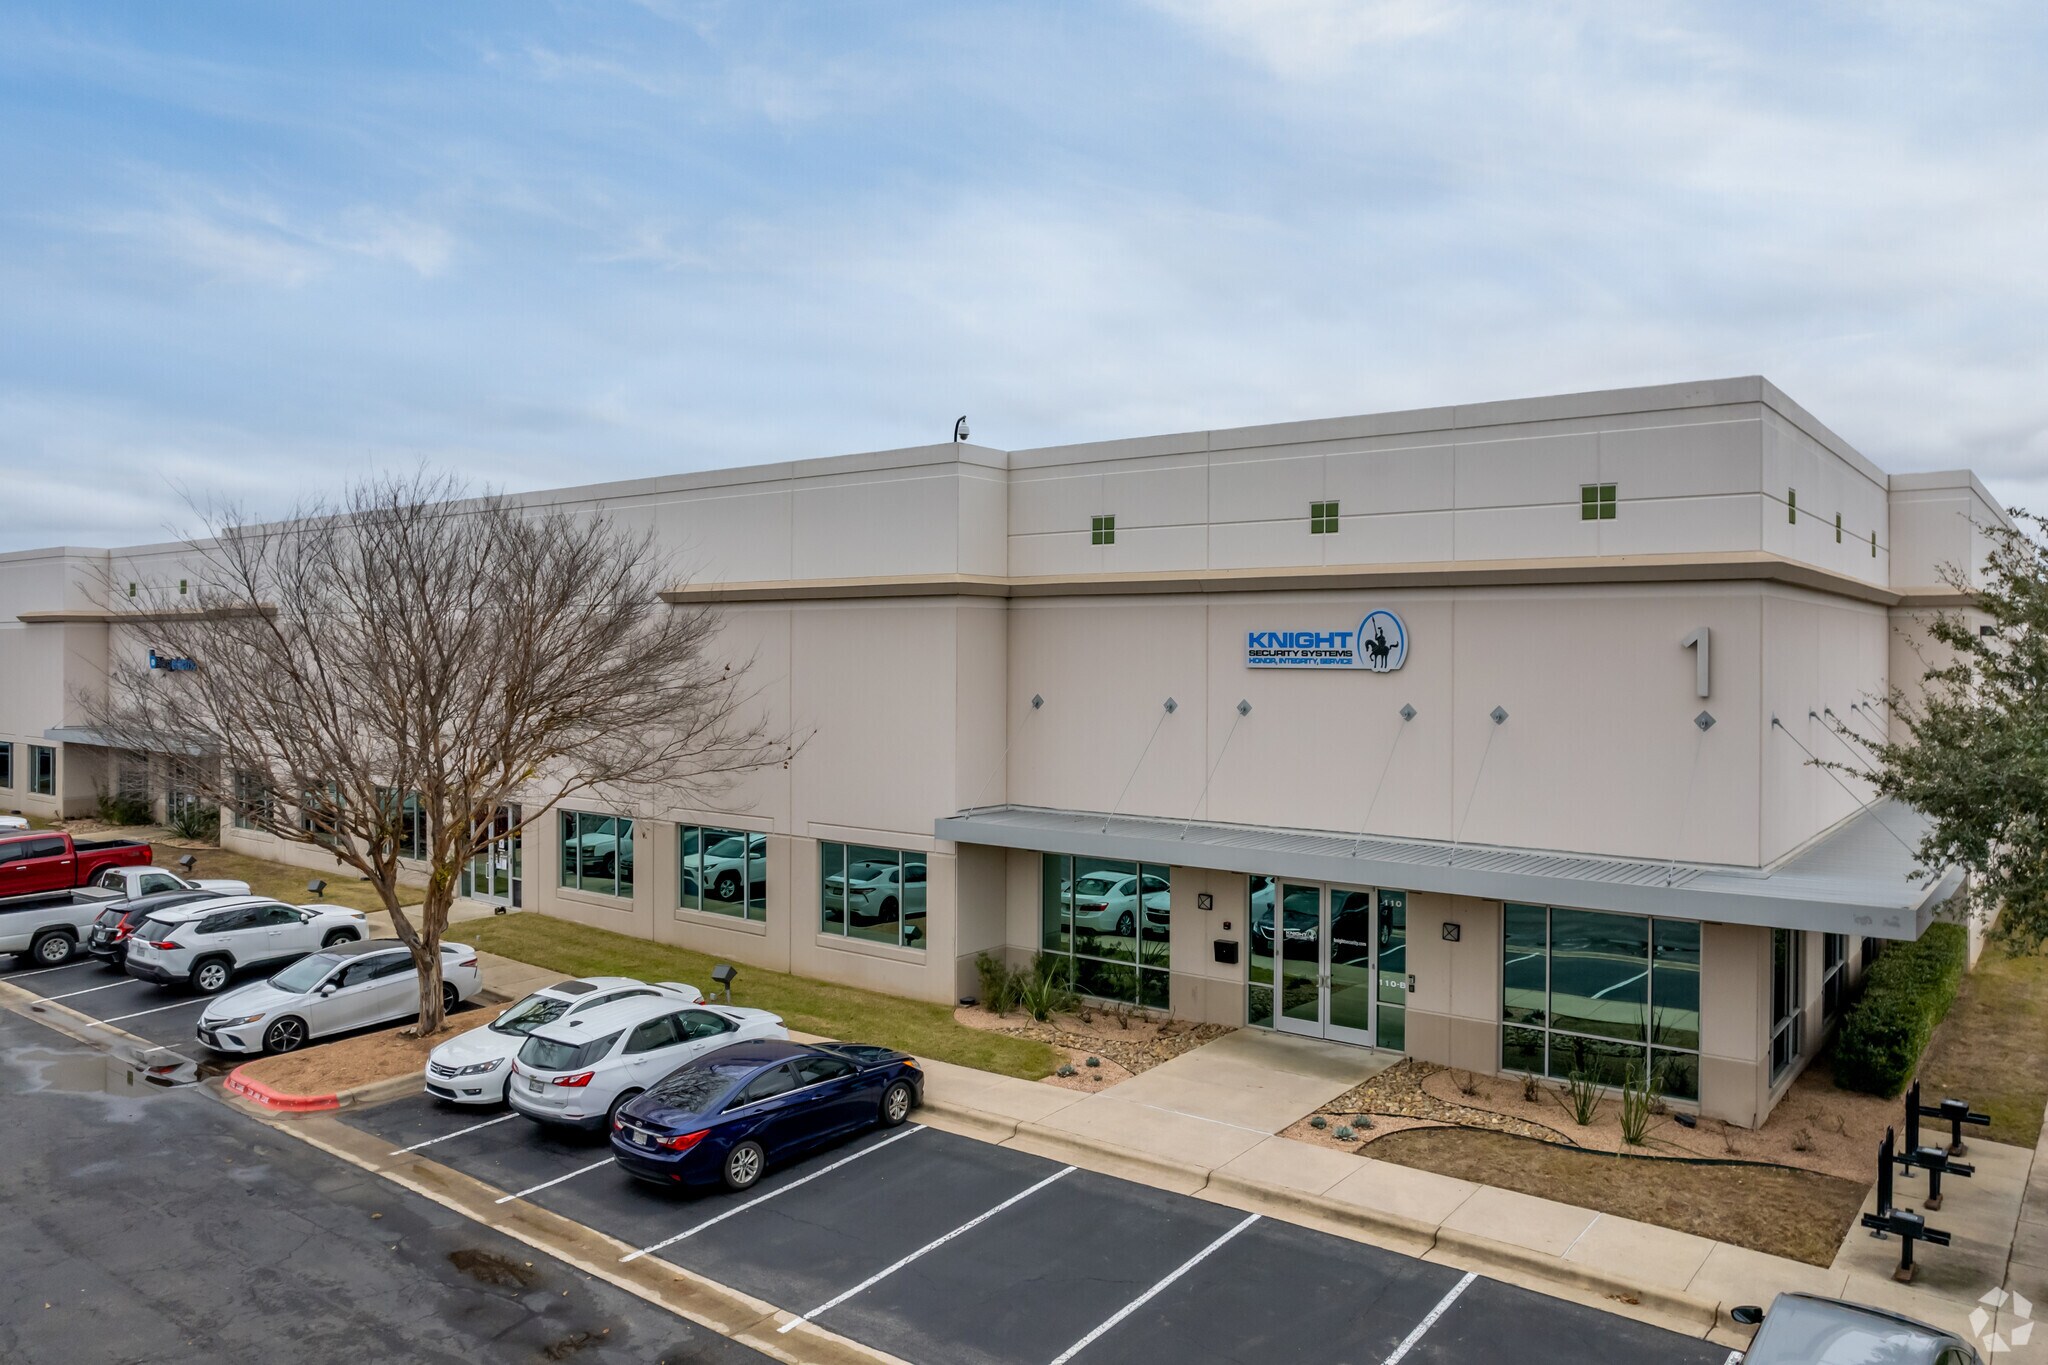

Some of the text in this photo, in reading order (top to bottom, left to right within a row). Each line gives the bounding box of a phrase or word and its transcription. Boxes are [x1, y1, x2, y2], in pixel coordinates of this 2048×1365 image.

[1248, 632, 1353, 649] KNIGHT
[1680, 627, 1710, 698] 1
[1379, 979, 1406, 989] 110-B
